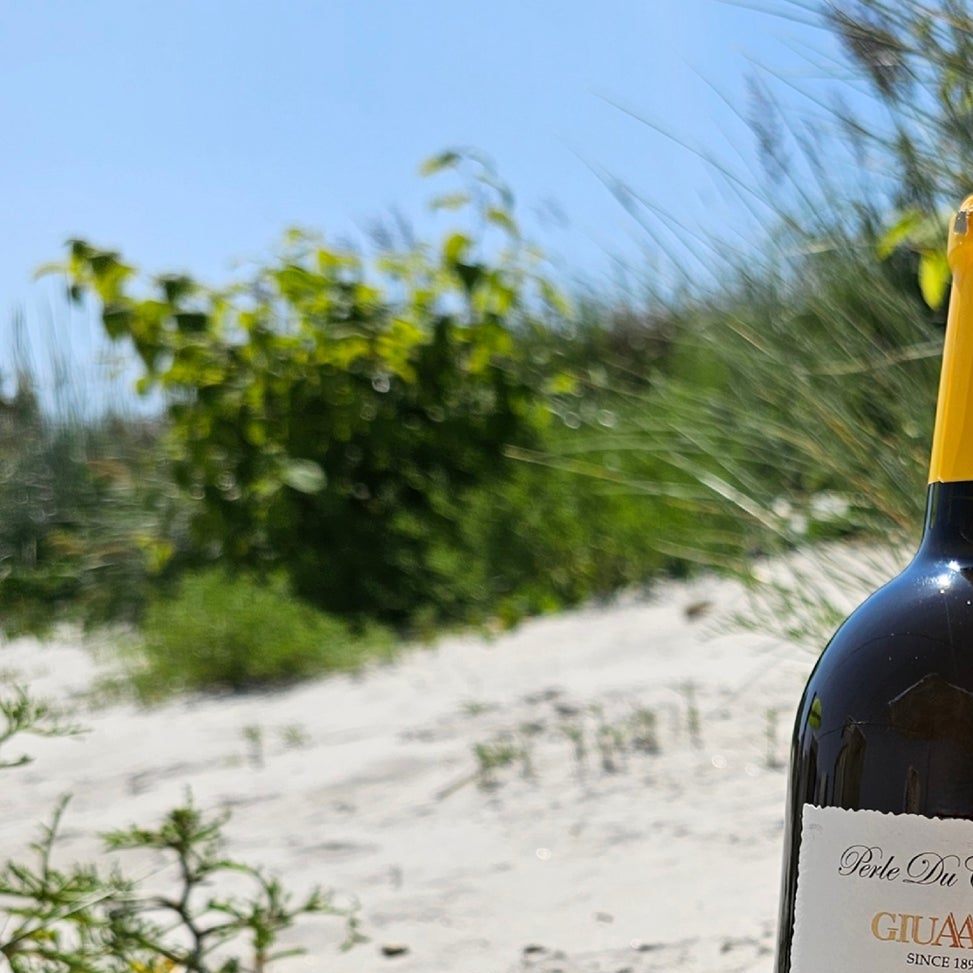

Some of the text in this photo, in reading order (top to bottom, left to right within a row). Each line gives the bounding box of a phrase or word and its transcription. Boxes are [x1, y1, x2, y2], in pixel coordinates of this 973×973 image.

[838, 845, 900, 882] Perle
[903, 852, 960, 887] Du
[906, 952, 950, 968] SINCE
